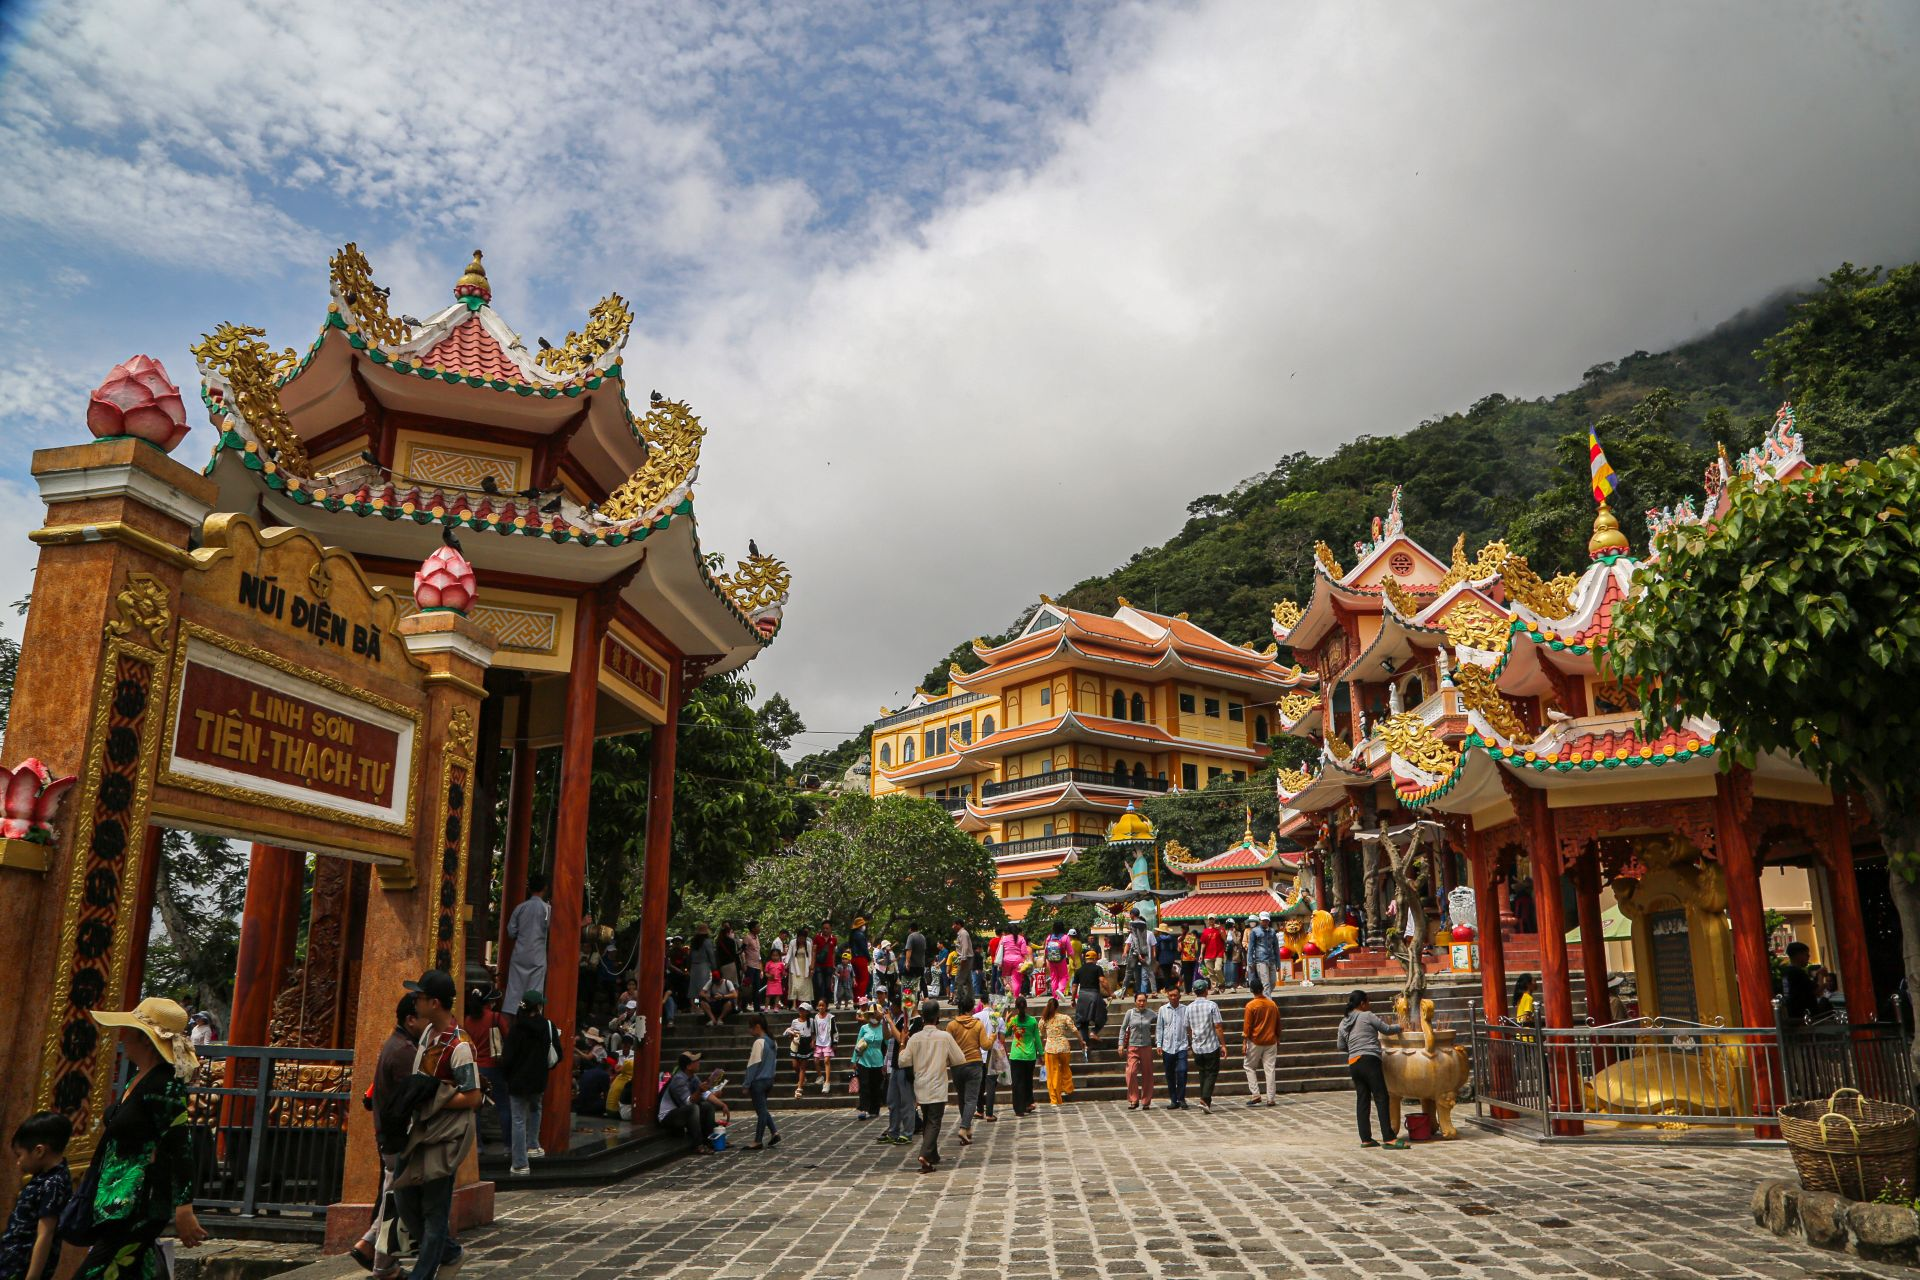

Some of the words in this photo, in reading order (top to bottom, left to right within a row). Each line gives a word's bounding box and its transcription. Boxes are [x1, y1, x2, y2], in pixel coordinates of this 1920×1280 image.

[238, 571, 285, 620] NÚI
[290, 595, 348, 647] ĐIỆN
[352, 623, 382, 662] BÀ
[250, 691, 304, 730] LINH
[311, 711, 355, 746] SƠN
